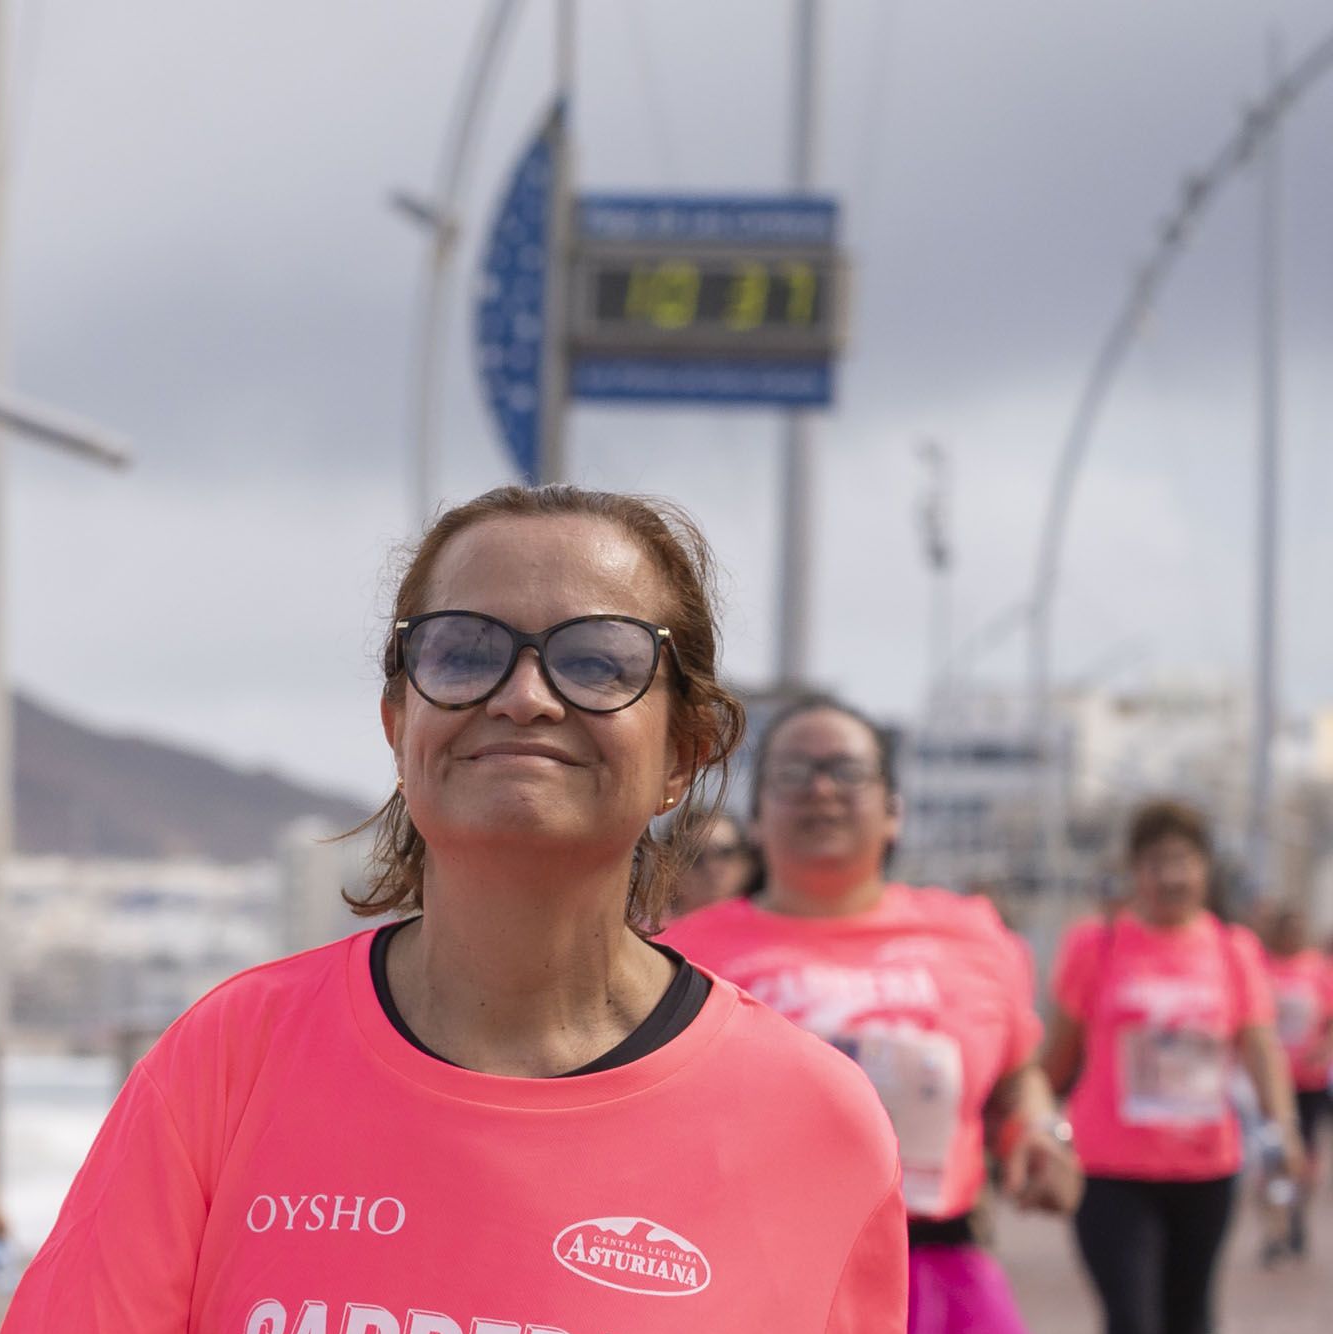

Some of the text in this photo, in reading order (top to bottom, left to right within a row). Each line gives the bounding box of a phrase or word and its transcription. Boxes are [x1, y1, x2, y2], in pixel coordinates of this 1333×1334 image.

[246, 1194, 406, 1235] OYSHO
[563, 1233, 699, 1288] ASTURIANA
[593, 1234, 698, 1264] CENTRAL LECHERA
